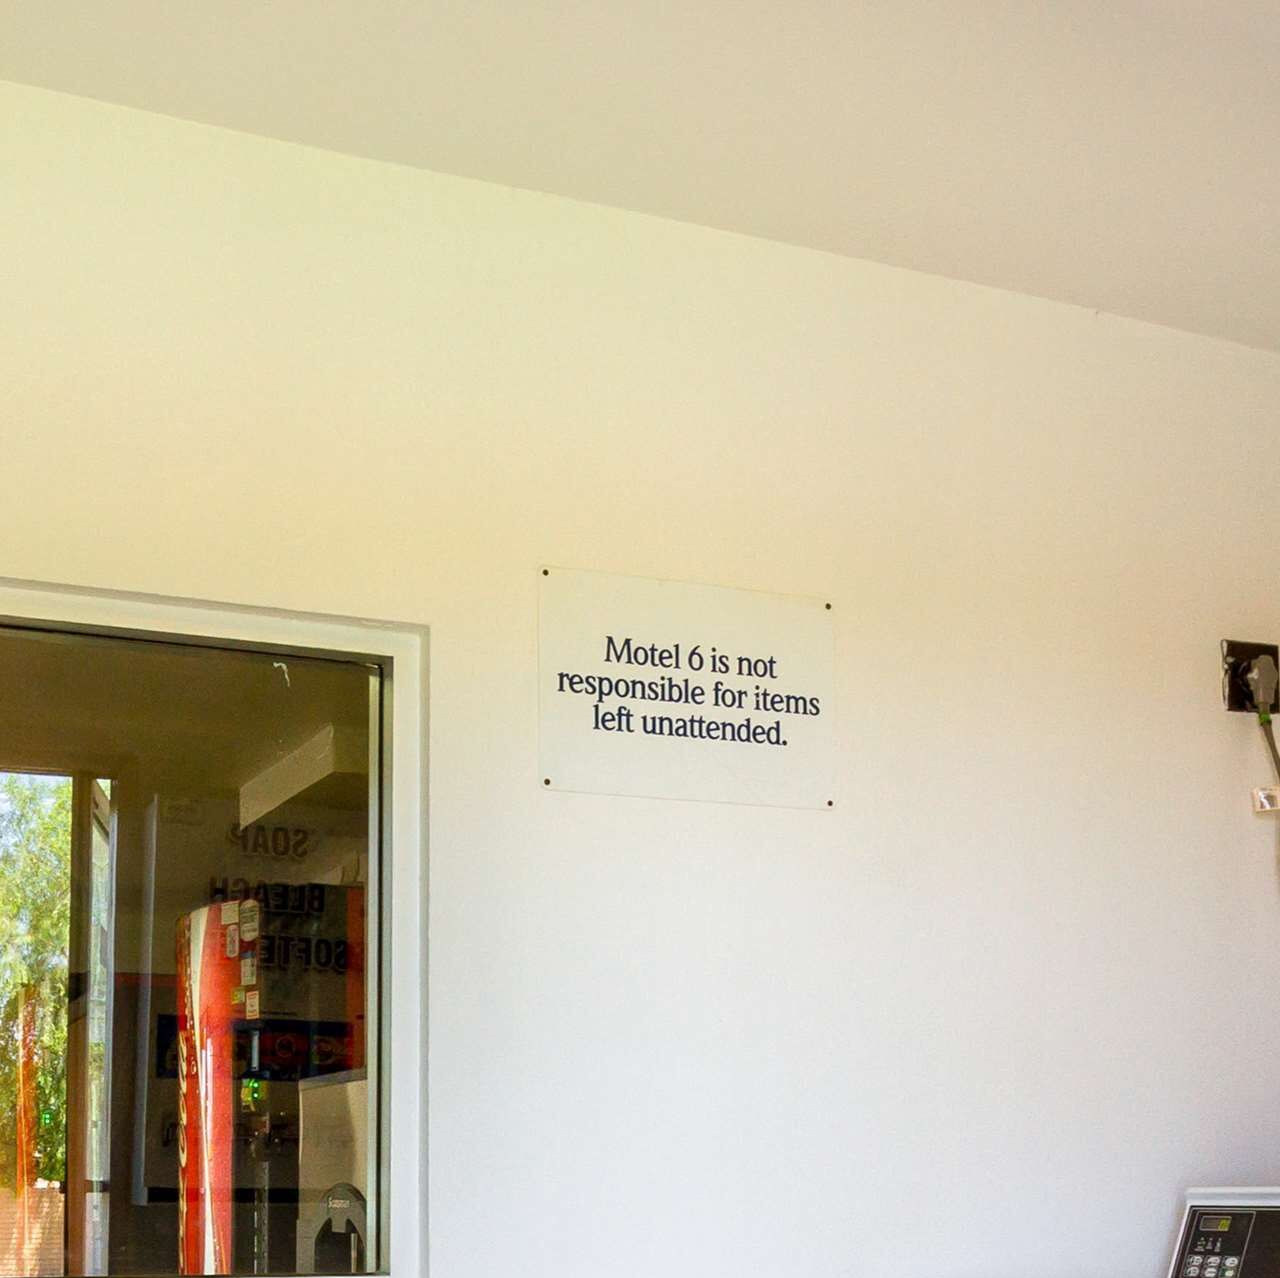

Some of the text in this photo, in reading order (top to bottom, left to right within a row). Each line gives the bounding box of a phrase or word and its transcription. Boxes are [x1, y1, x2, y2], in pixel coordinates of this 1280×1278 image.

[604, 635, 778, 679] Motel 6 is not
[556, 671, 821, 717] responsible for items
[592, 705, 788, 746] left unattended.
